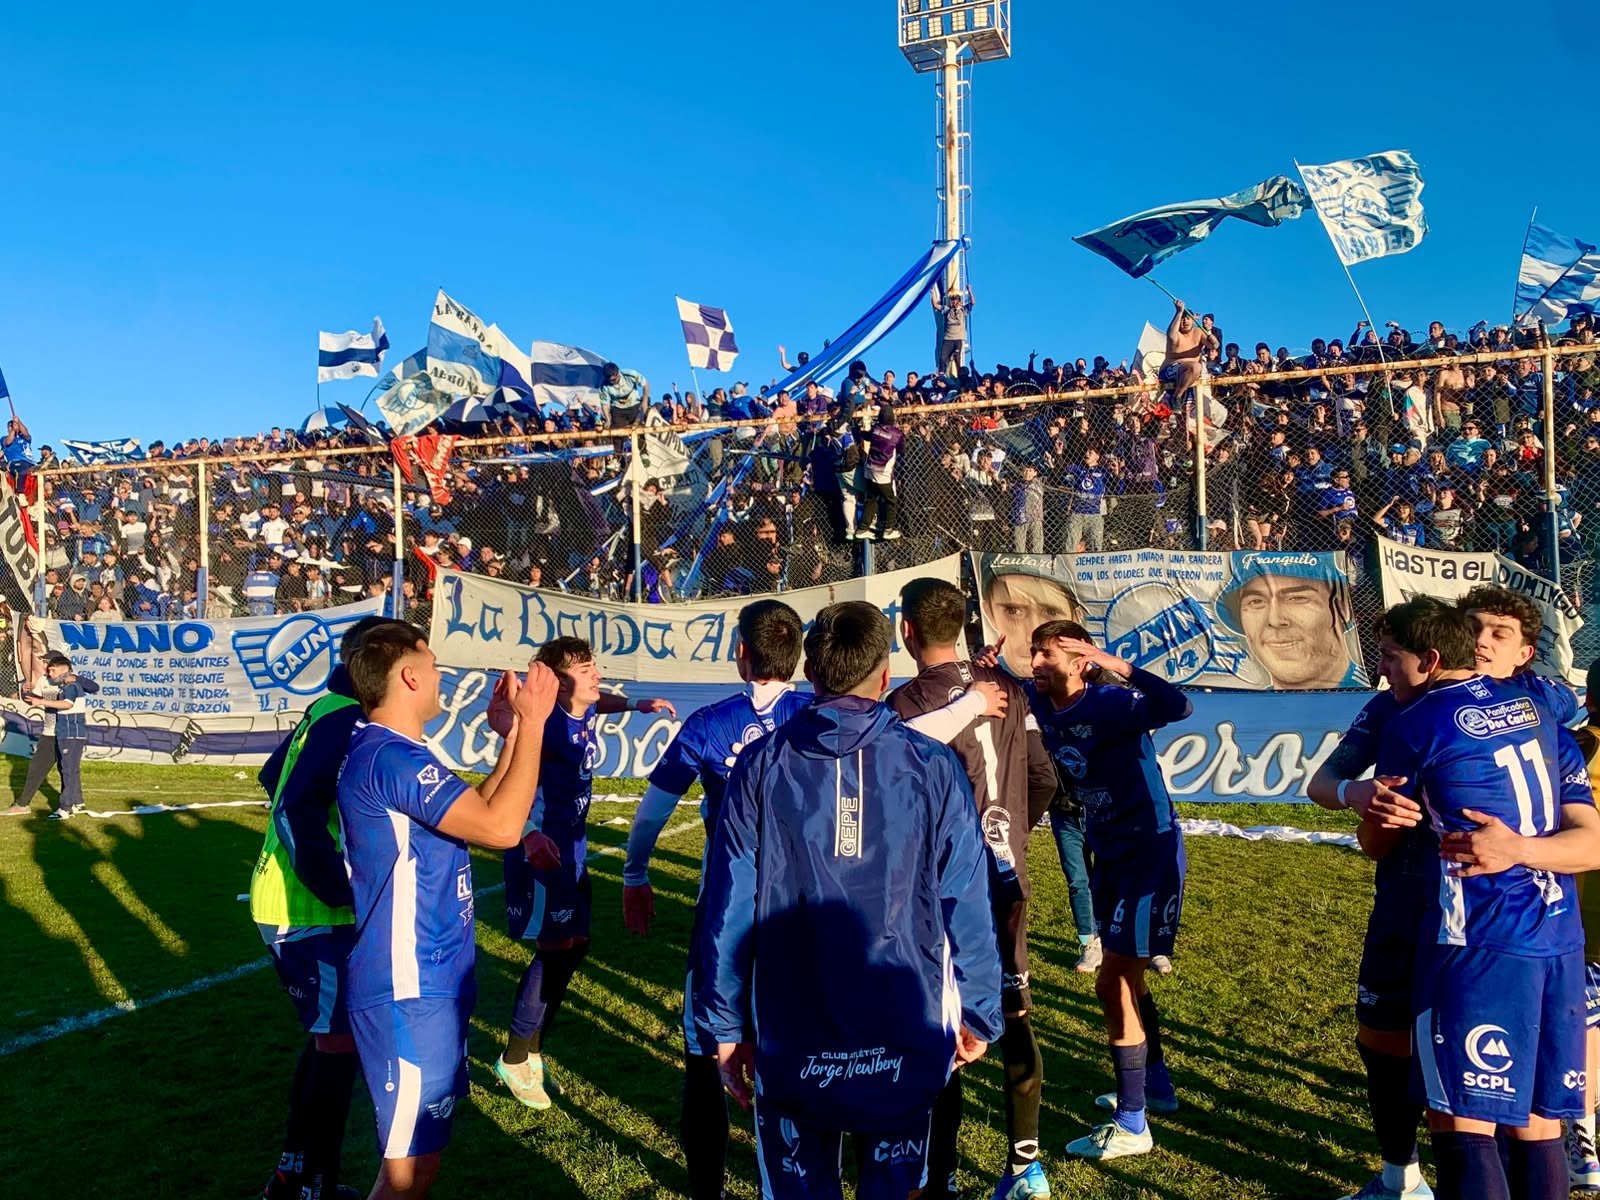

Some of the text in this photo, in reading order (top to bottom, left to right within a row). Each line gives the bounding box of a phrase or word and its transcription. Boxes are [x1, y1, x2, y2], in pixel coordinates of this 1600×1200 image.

[990, 553, 1055, 569] Lautaro
[1075, 555, 1106, 567] SIEMPRE
[1169, 553, 1185, 565] UNA
[1188, 553, 1223, 565] BANDERA
[1242, 552, 1318, 571] Franquito
[1077, 571, 1094, 582] CON
[1097, 569, 1110, 581] LOS
[1113, 568, 1145, 579] COLORES
[443, 575, 504, 642] La
[59, 622, 216, 653] NANO
[1116, 603, 1198, 661] CAJN
[116, 658, 148, 669] DONDE
[153, 658, 164, 669] TE
[169, 656, 230, 669] ENCUENTRES
[272, 625, 330, 681] CAJN
[101, 671, 125, 683] FELIZ
[128, 672, 136, 684] Y
[139, 672, 175, 684] TENGAS
[179, 672, 225, 685] PRESENTE
[127, 687, 174, 698] HINCHADA
[178, 688, 187, 698] TE
[85, 698, 107, 710] POR
[111, 699, 149, 711] SIEMPRE
[152, 701, 166, 711] EN
[255, 693, 290, 712] La
[1485, 701, 1531, 718] Panificadora
[1486, 710, 1537, 731] Don Carlos
[973, 721, 998, 801] 1
[1493, 738, 1555, 837] 11
[840, 797, 858, 857] GEPE
[821, 1047, 886, 1060] CLUB ATLÉTICO
[800, 1054, 904, 1088] Jorge Newbery
[1463, 1071, 1517, 1094] SCPL
